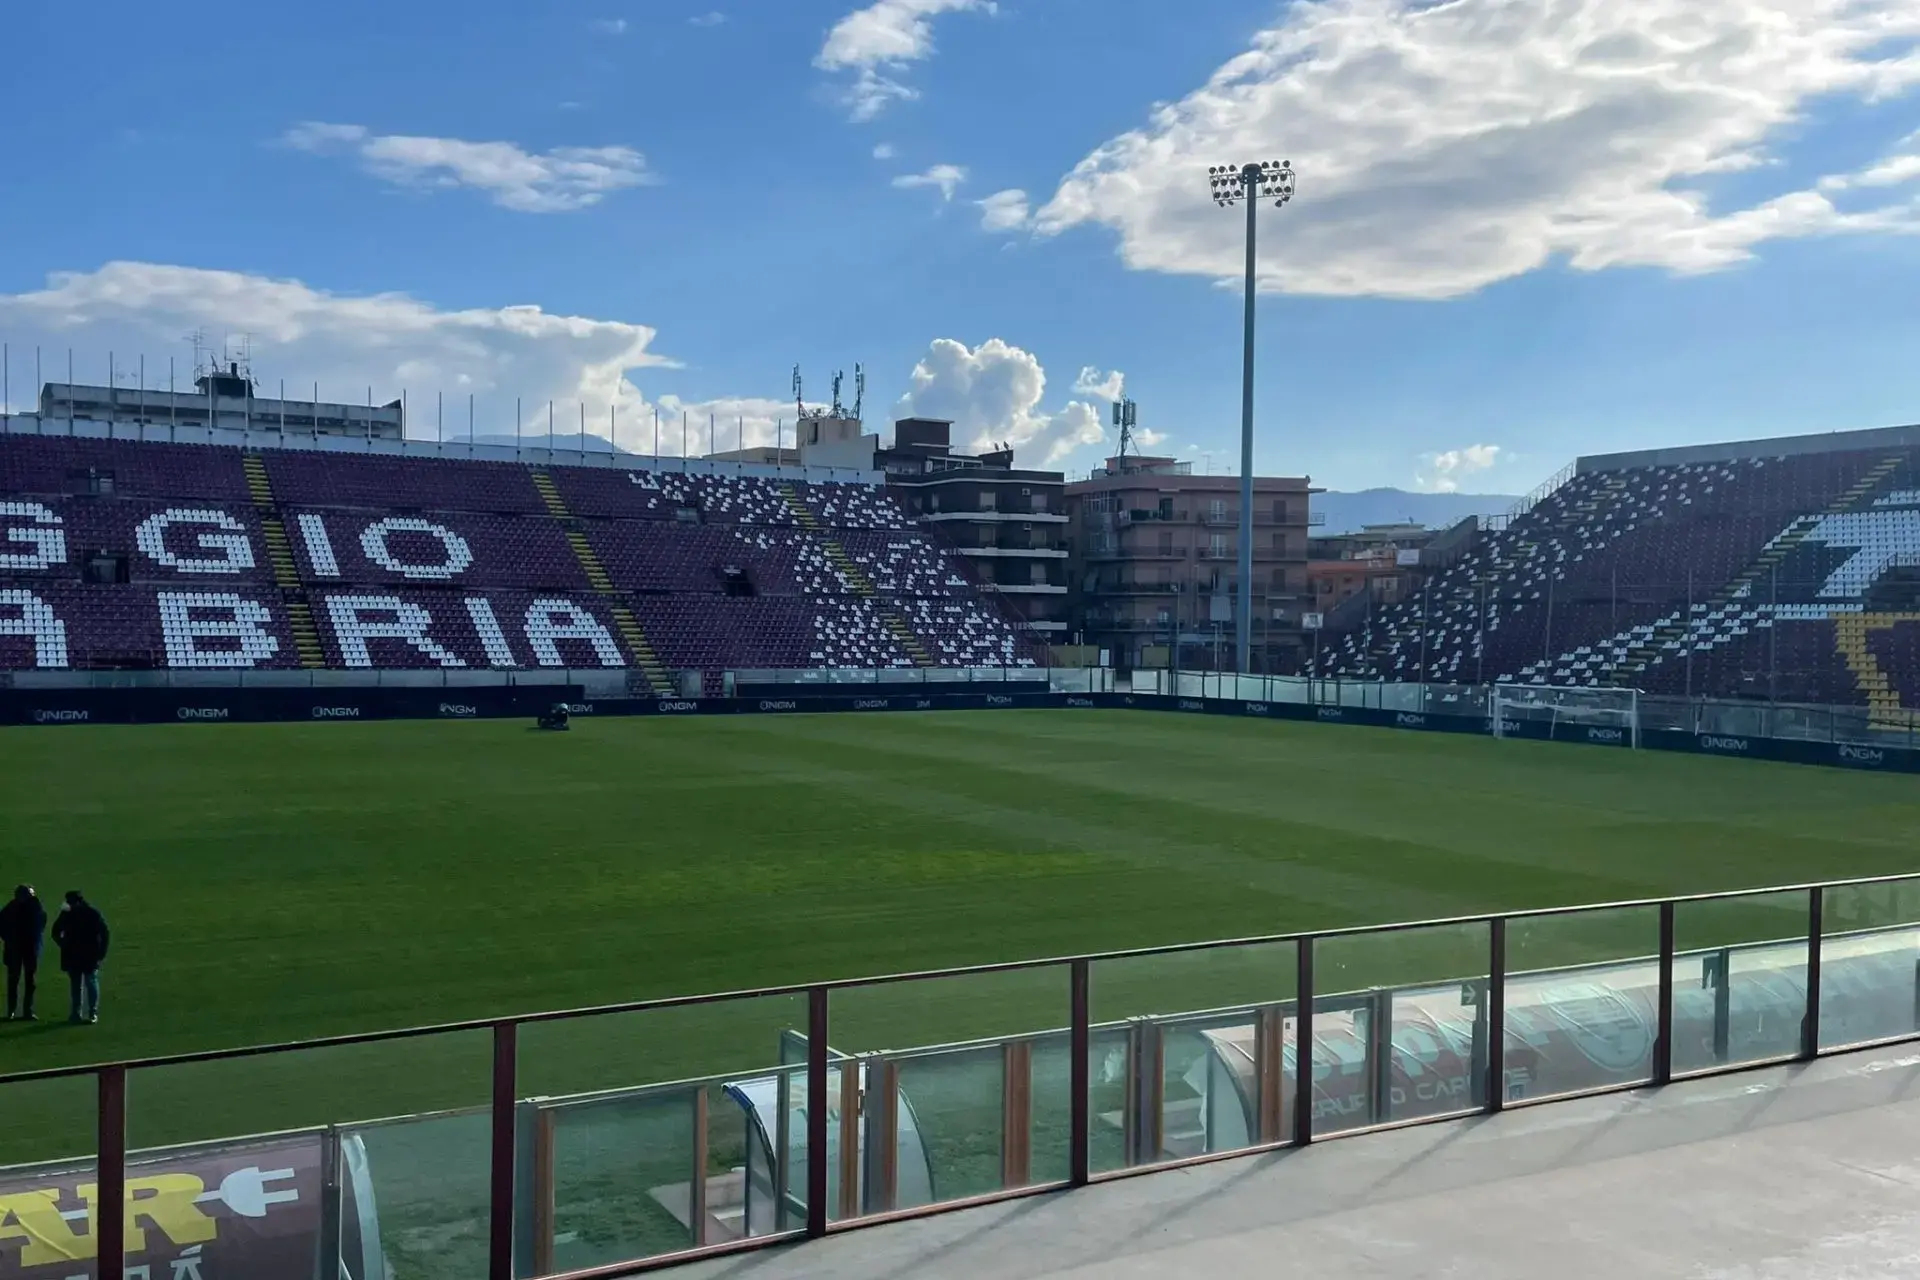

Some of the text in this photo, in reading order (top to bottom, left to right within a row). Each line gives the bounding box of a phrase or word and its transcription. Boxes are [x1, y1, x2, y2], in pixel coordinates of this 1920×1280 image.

[445, 704, 477, 715] NGM
[668, 702, 697, 710] NGM
[44, 710, 88, 720] NGM
[188, 708, 228, 718] NGM
[324, 707, 360, 717] NGM
[1593, 729, 1622, 740] NGM
[1711, 736, 1748, 750] NGM
[1847, 746, 1884, 761] NGM
